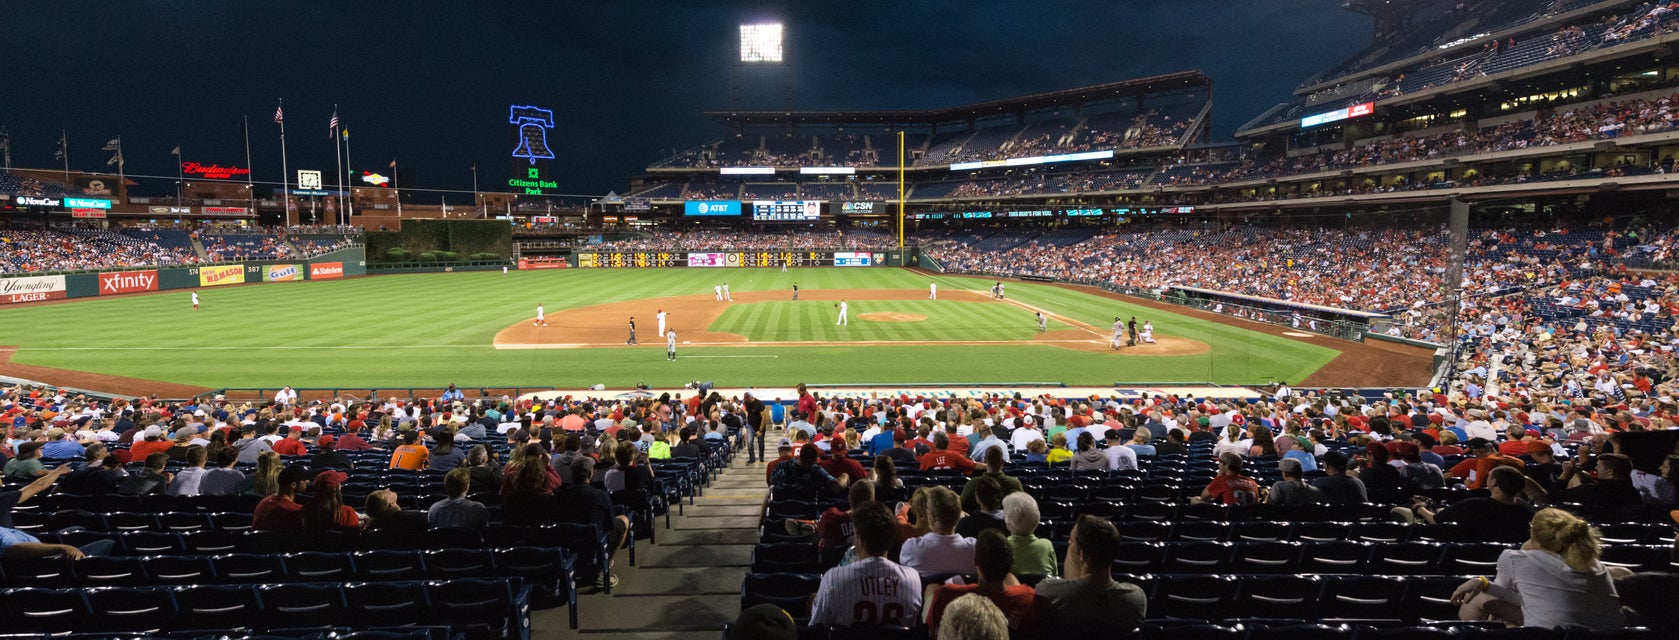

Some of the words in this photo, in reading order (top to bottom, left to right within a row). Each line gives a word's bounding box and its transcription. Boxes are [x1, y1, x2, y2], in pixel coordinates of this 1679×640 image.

[509, 179, 538, 187] Citizens
[540, 180, 558, 188] Bank
[25, 197, 59, 206] NovaCare
[271, 266, 296, 279] Gulf
[0, 279, 55, 291] Yuengling
[104, 272, 154, 292] xfinity
[12, 293, 46, 302] LAGER
[935, 456, 946, 465] LEE
[841, 521, 856, 537] DA
[860, 576, 899, 597] UTLEY
